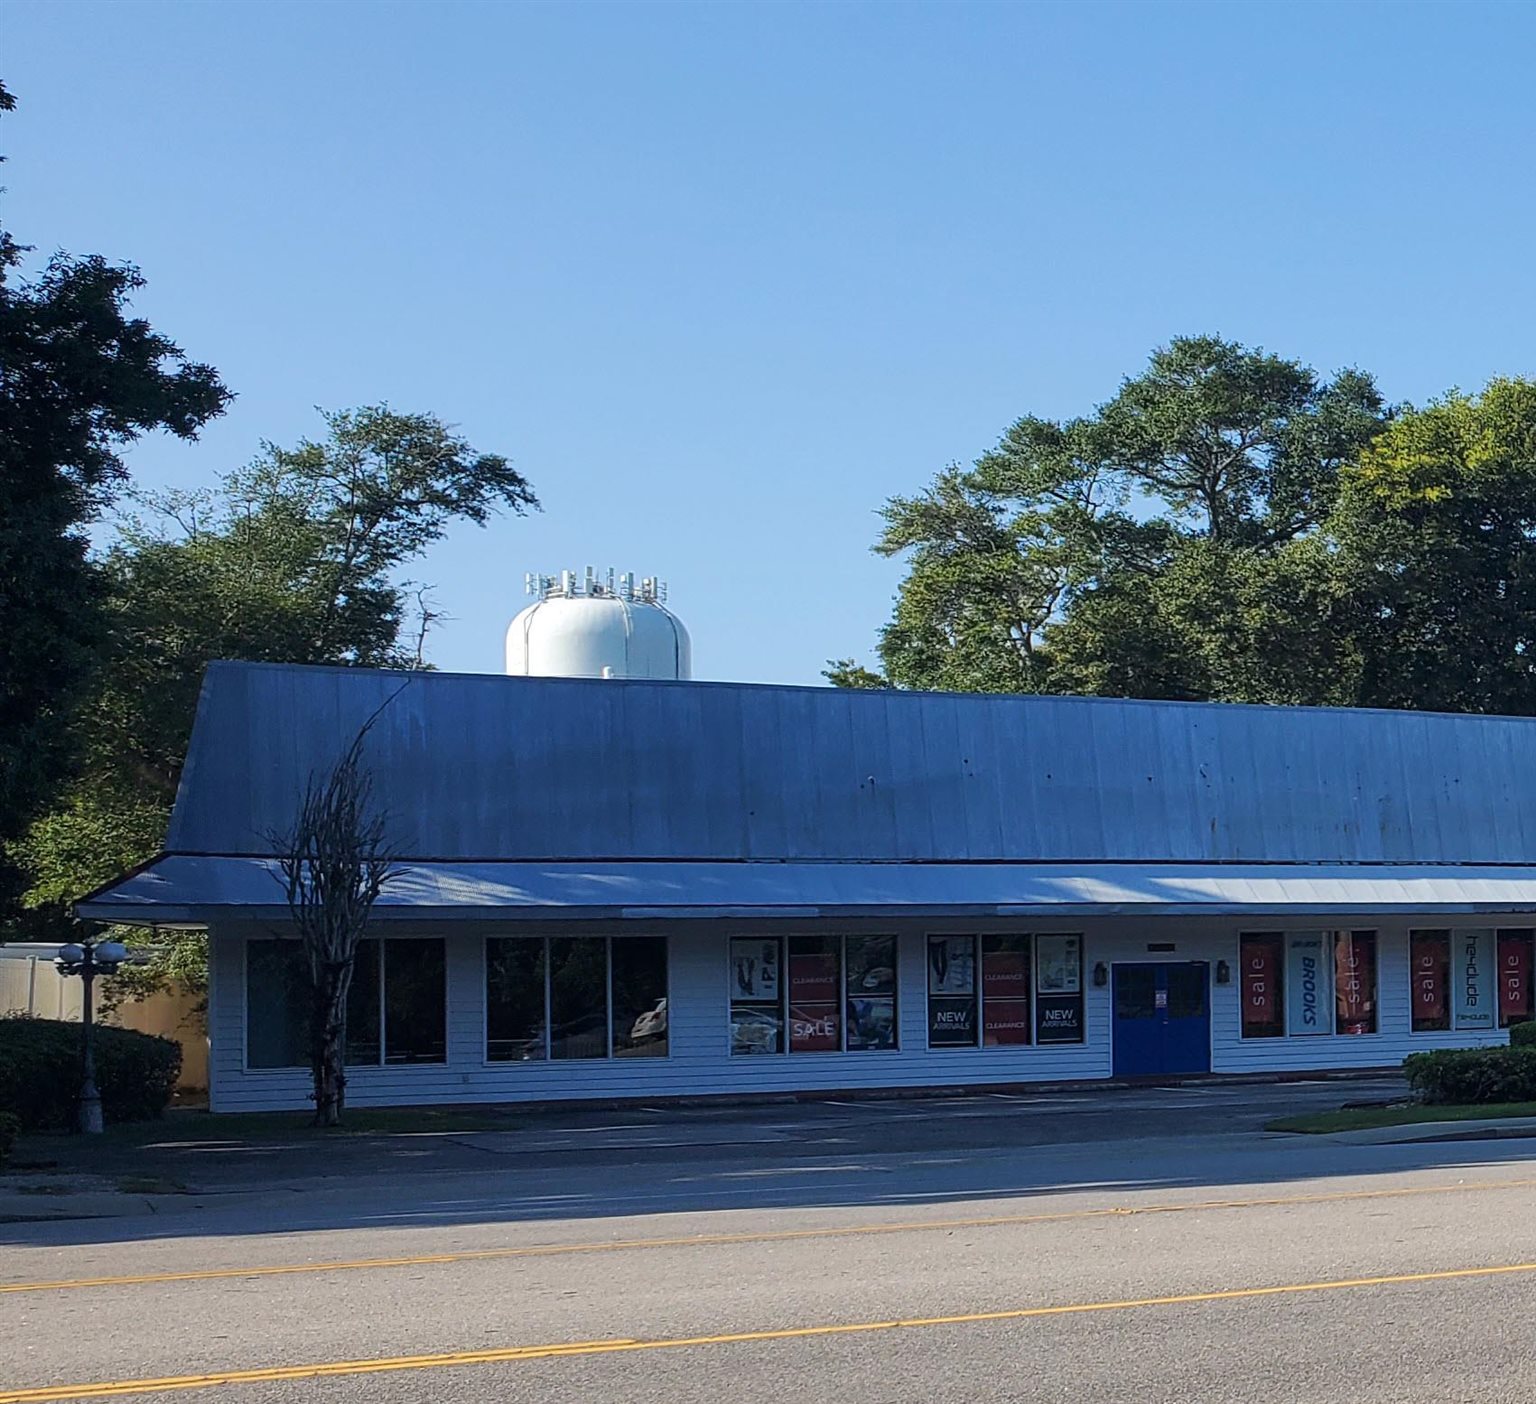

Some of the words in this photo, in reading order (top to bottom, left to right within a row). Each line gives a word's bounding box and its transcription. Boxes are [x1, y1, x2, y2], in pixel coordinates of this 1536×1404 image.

[792, 976, 834, 984] CLEARANCE
[985, 973, 1023, 981] CLEARANCE
[1249, 958, 1266, 1006] sale
[1419, 956, 1434, 1002] sale
[1504, 955, 1520, 1000] sale
[1302, 956, 1316, 1026] BROOKS
[937, 1011, 967, 1022] NEW
[1045, 1009, 1074, 1020] NEW
[793, 1021, 835, 1037] SALE
[933, 1022, 971, 1031] ARRIVALS
[985, 1021, 1025, 1030] CLEARANCE
[1041, 1020, 1078, 1028] ARRIVALS
